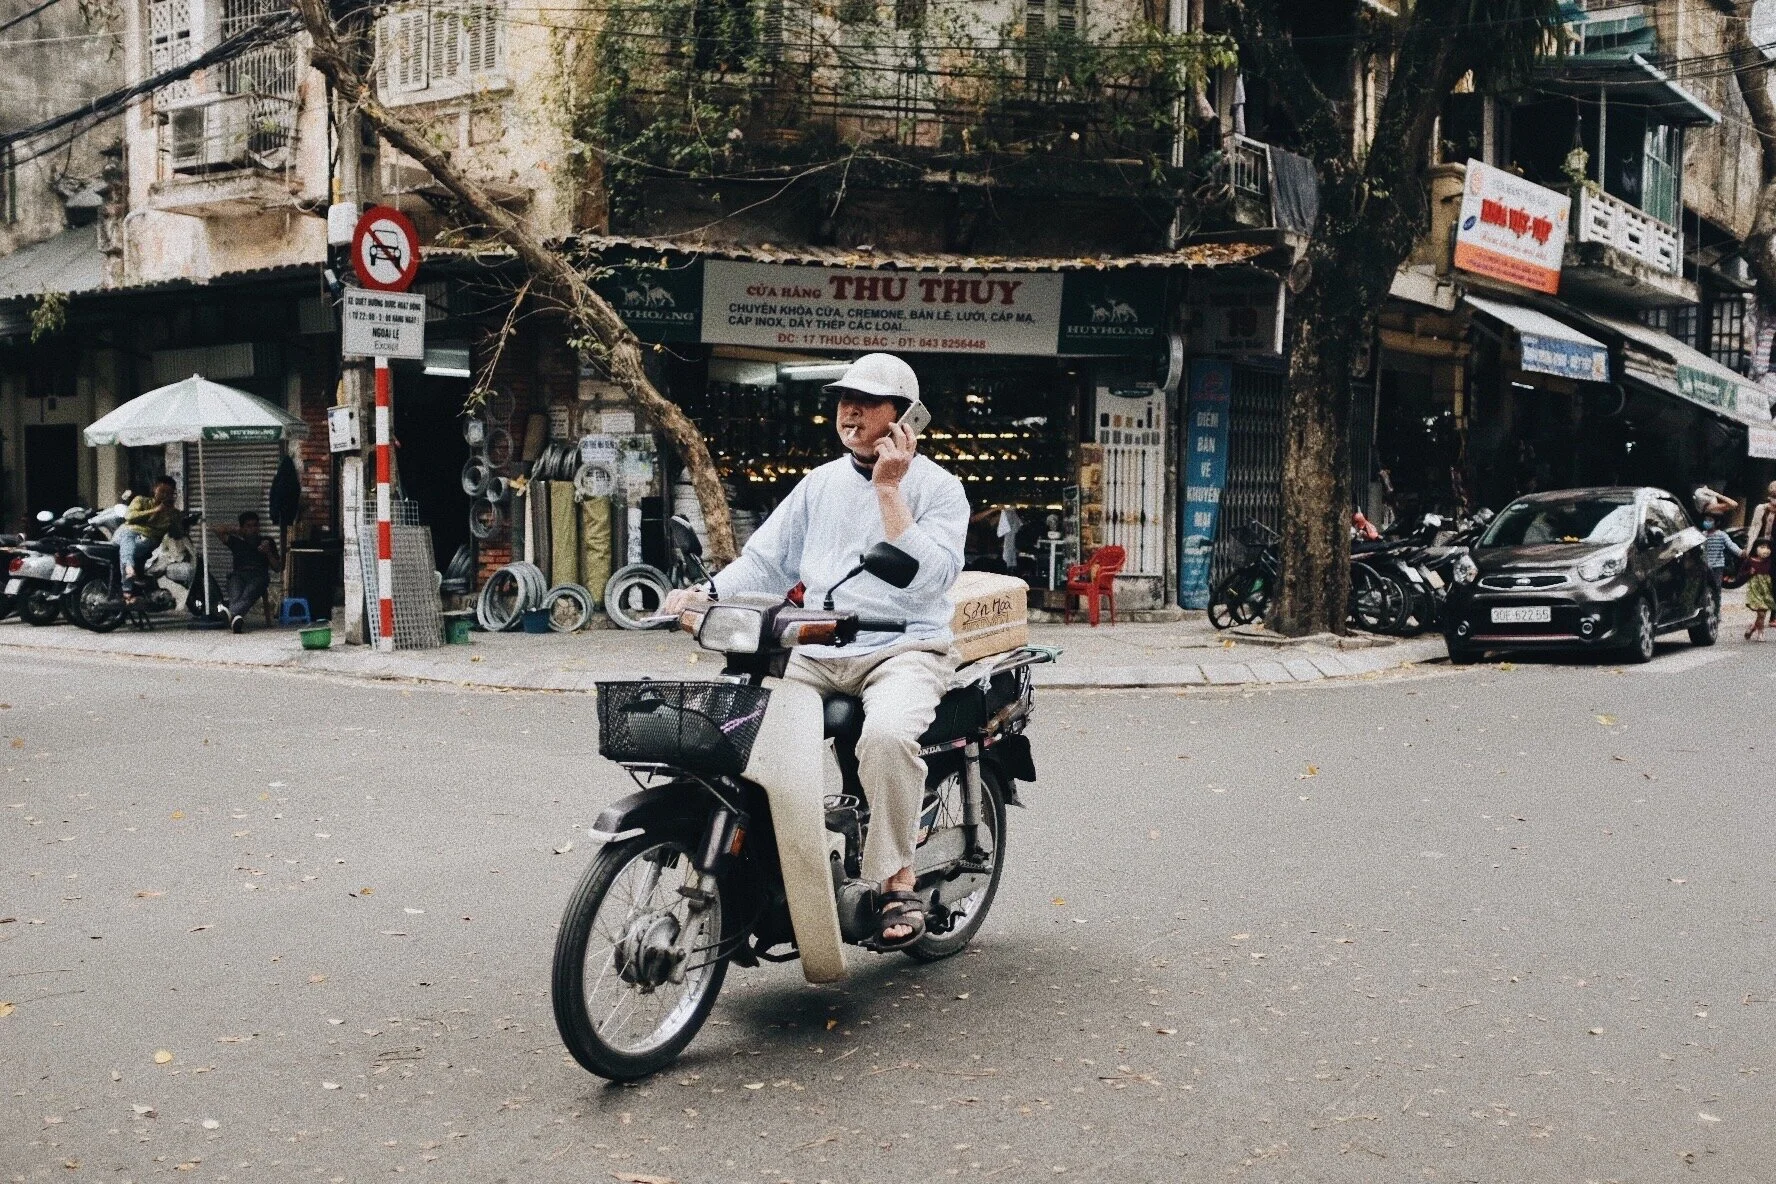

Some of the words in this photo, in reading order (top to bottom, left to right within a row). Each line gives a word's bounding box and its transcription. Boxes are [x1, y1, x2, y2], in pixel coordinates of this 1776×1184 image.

[746, 283, 777, 297] CỬA
[781, 284, 822, 299] HÀNG
[829, 275, 908, 303] THU
[803, 334, 815, 344] 17
[919, 338, 938, 348] 043
[917, 745, 942, 757] ONDA
